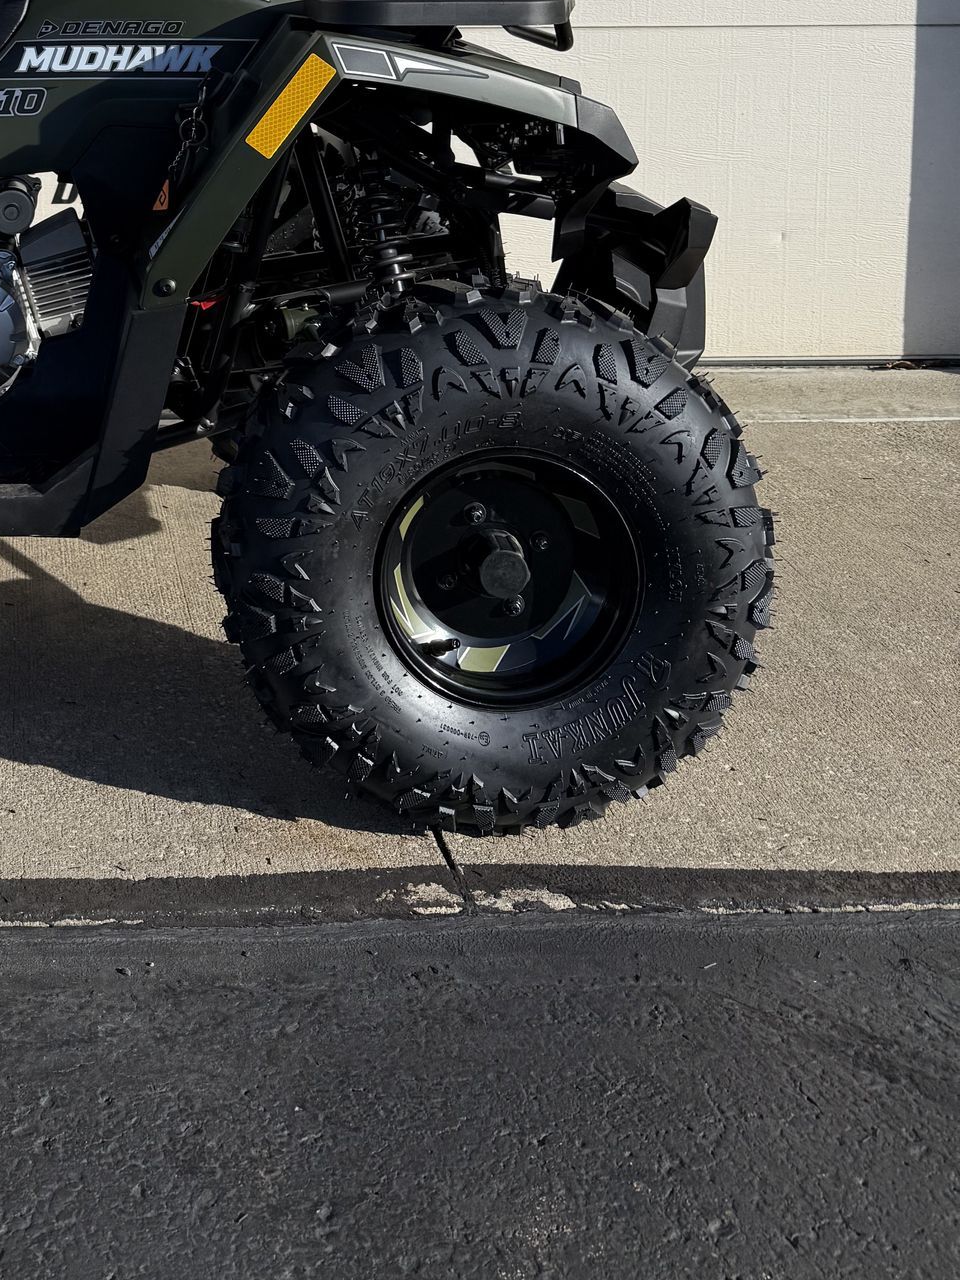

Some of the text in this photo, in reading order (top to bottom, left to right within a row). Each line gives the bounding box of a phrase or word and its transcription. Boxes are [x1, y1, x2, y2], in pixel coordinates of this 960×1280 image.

[60, 20, 185, 36] DENAGO
[15, 44, 224, 73] MUDHAWK
[523, 675, 647, 764] JUNKAI
